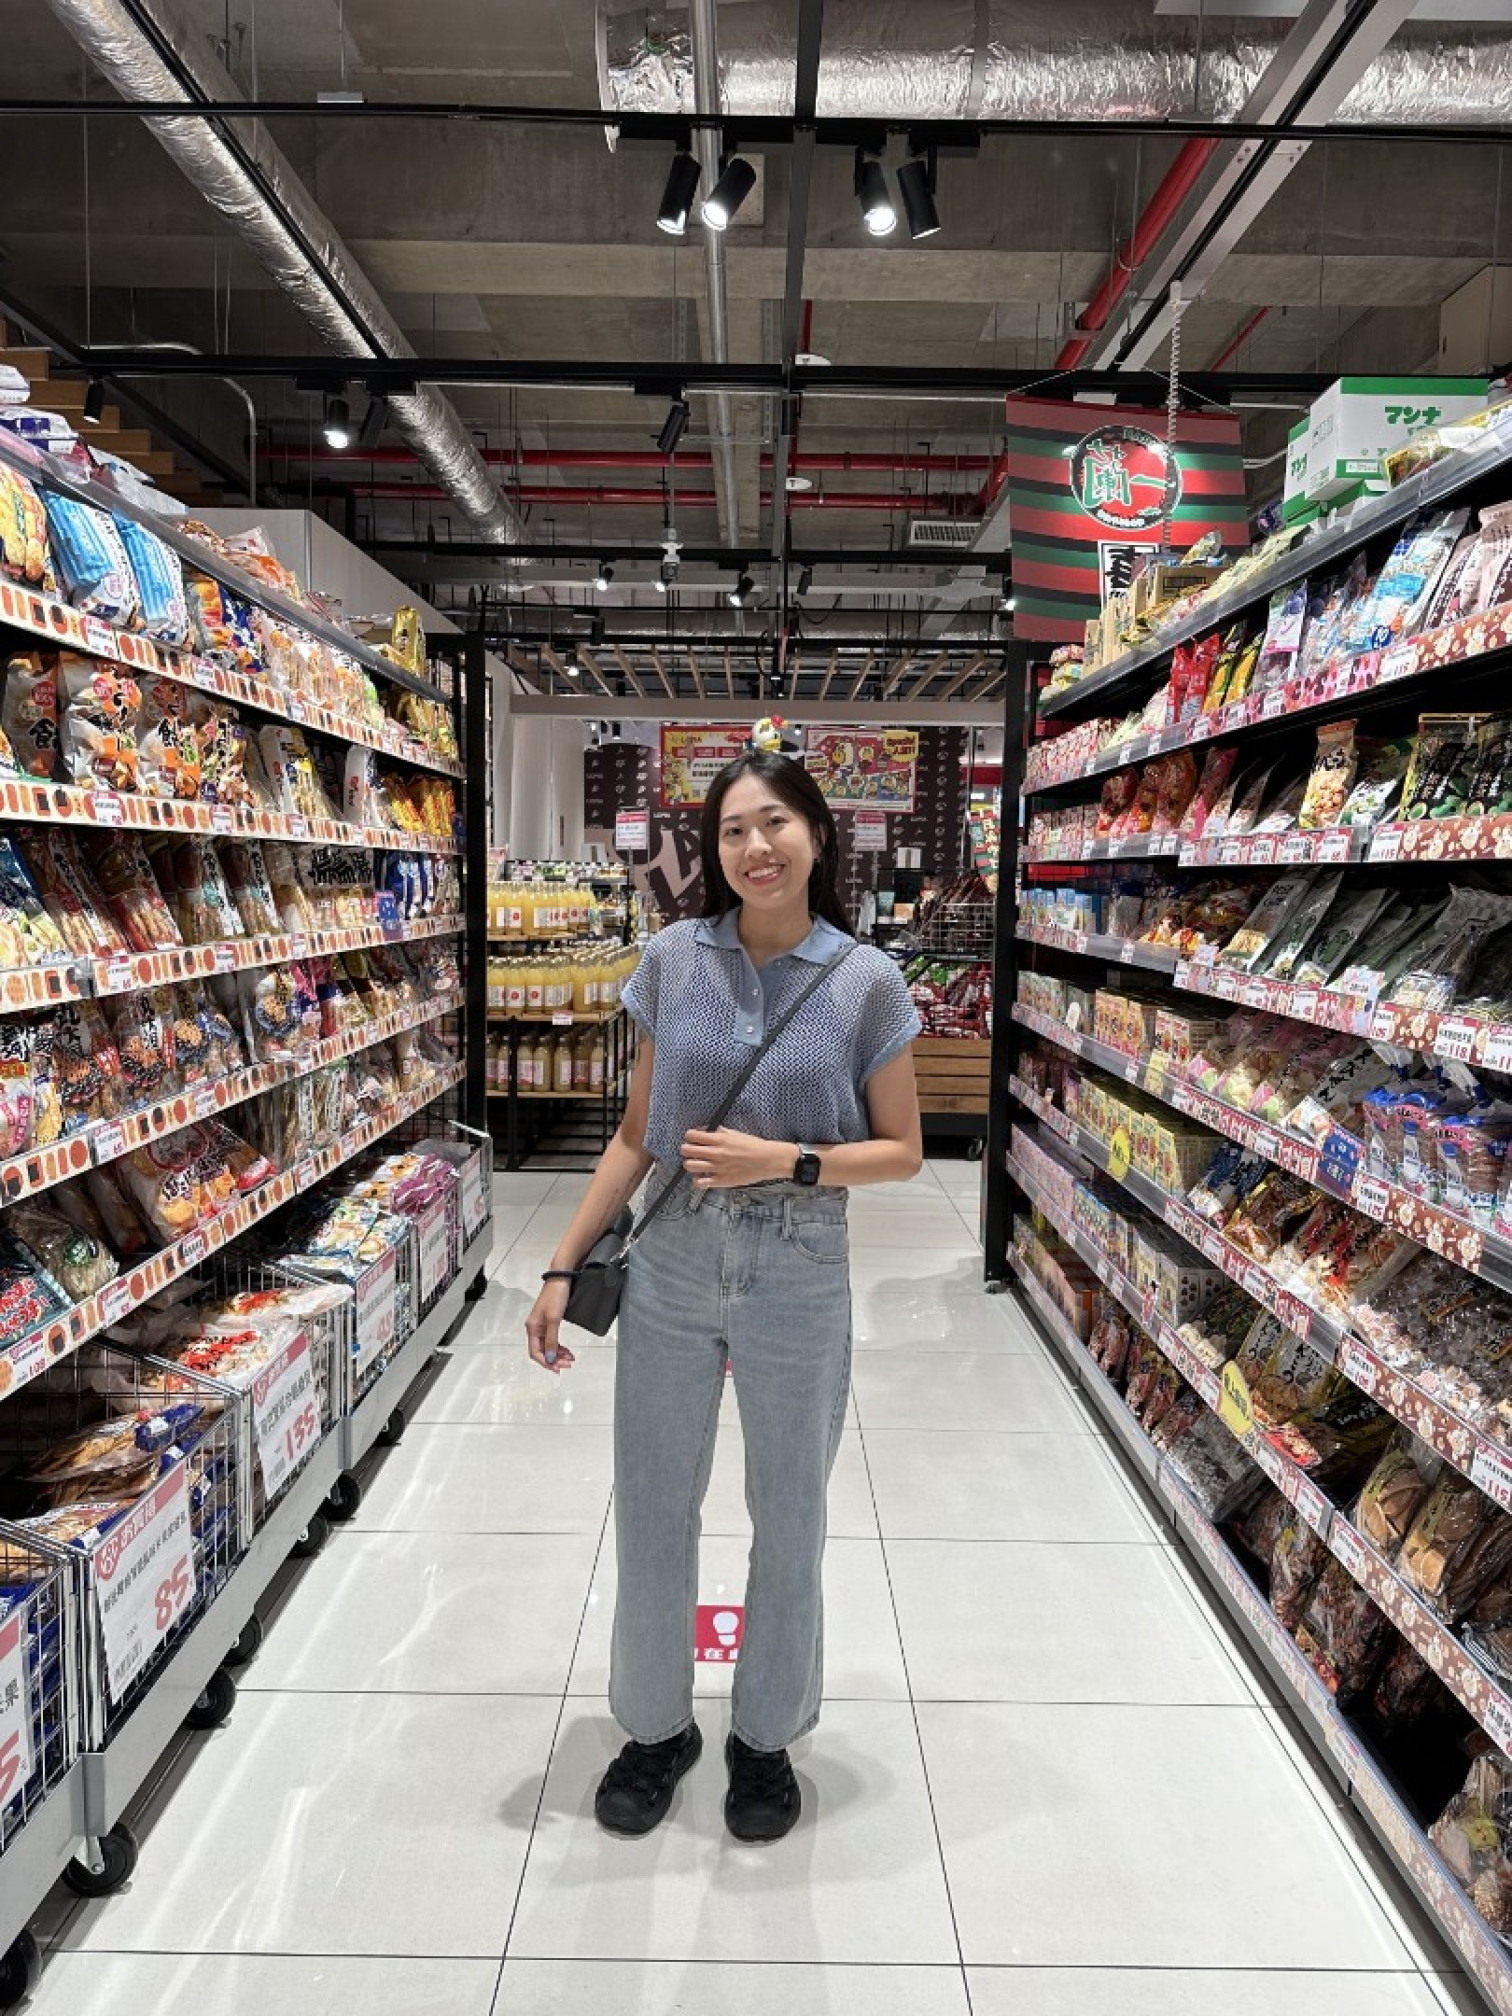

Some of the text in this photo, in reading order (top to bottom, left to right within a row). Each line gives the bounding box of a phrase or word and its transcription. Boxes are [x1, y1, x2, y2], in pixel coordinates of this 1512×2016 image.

[1384, 406, 1441, 426] マンナ
[1449, 1043, 1468, 1059] 118
[286, 1402, 315, 1461] 135
[155, 1553, 189, 1630] 85
